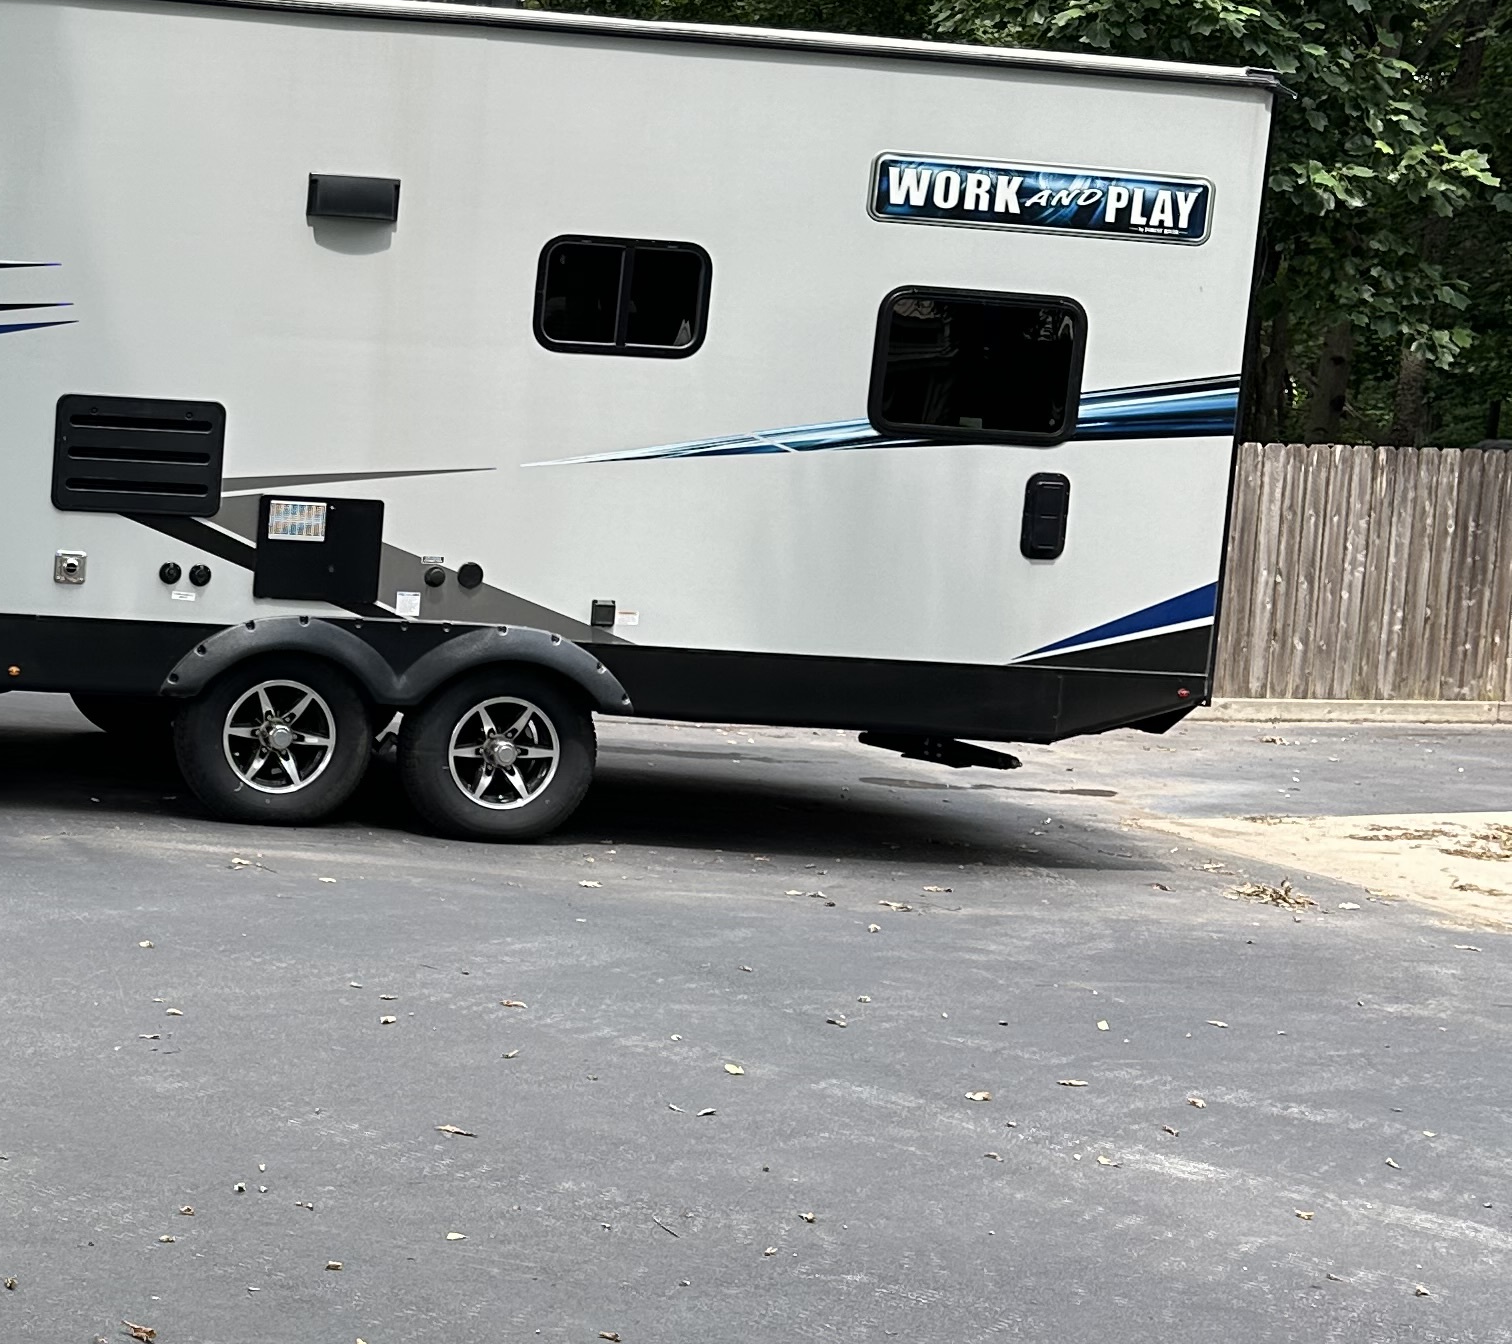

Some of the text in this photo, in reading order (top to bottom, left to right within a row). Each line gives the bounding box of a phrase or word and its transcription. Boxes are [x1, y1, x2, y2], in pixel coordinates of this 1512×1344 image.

[888, 166, 1200, 229] WORK AND PLAY
